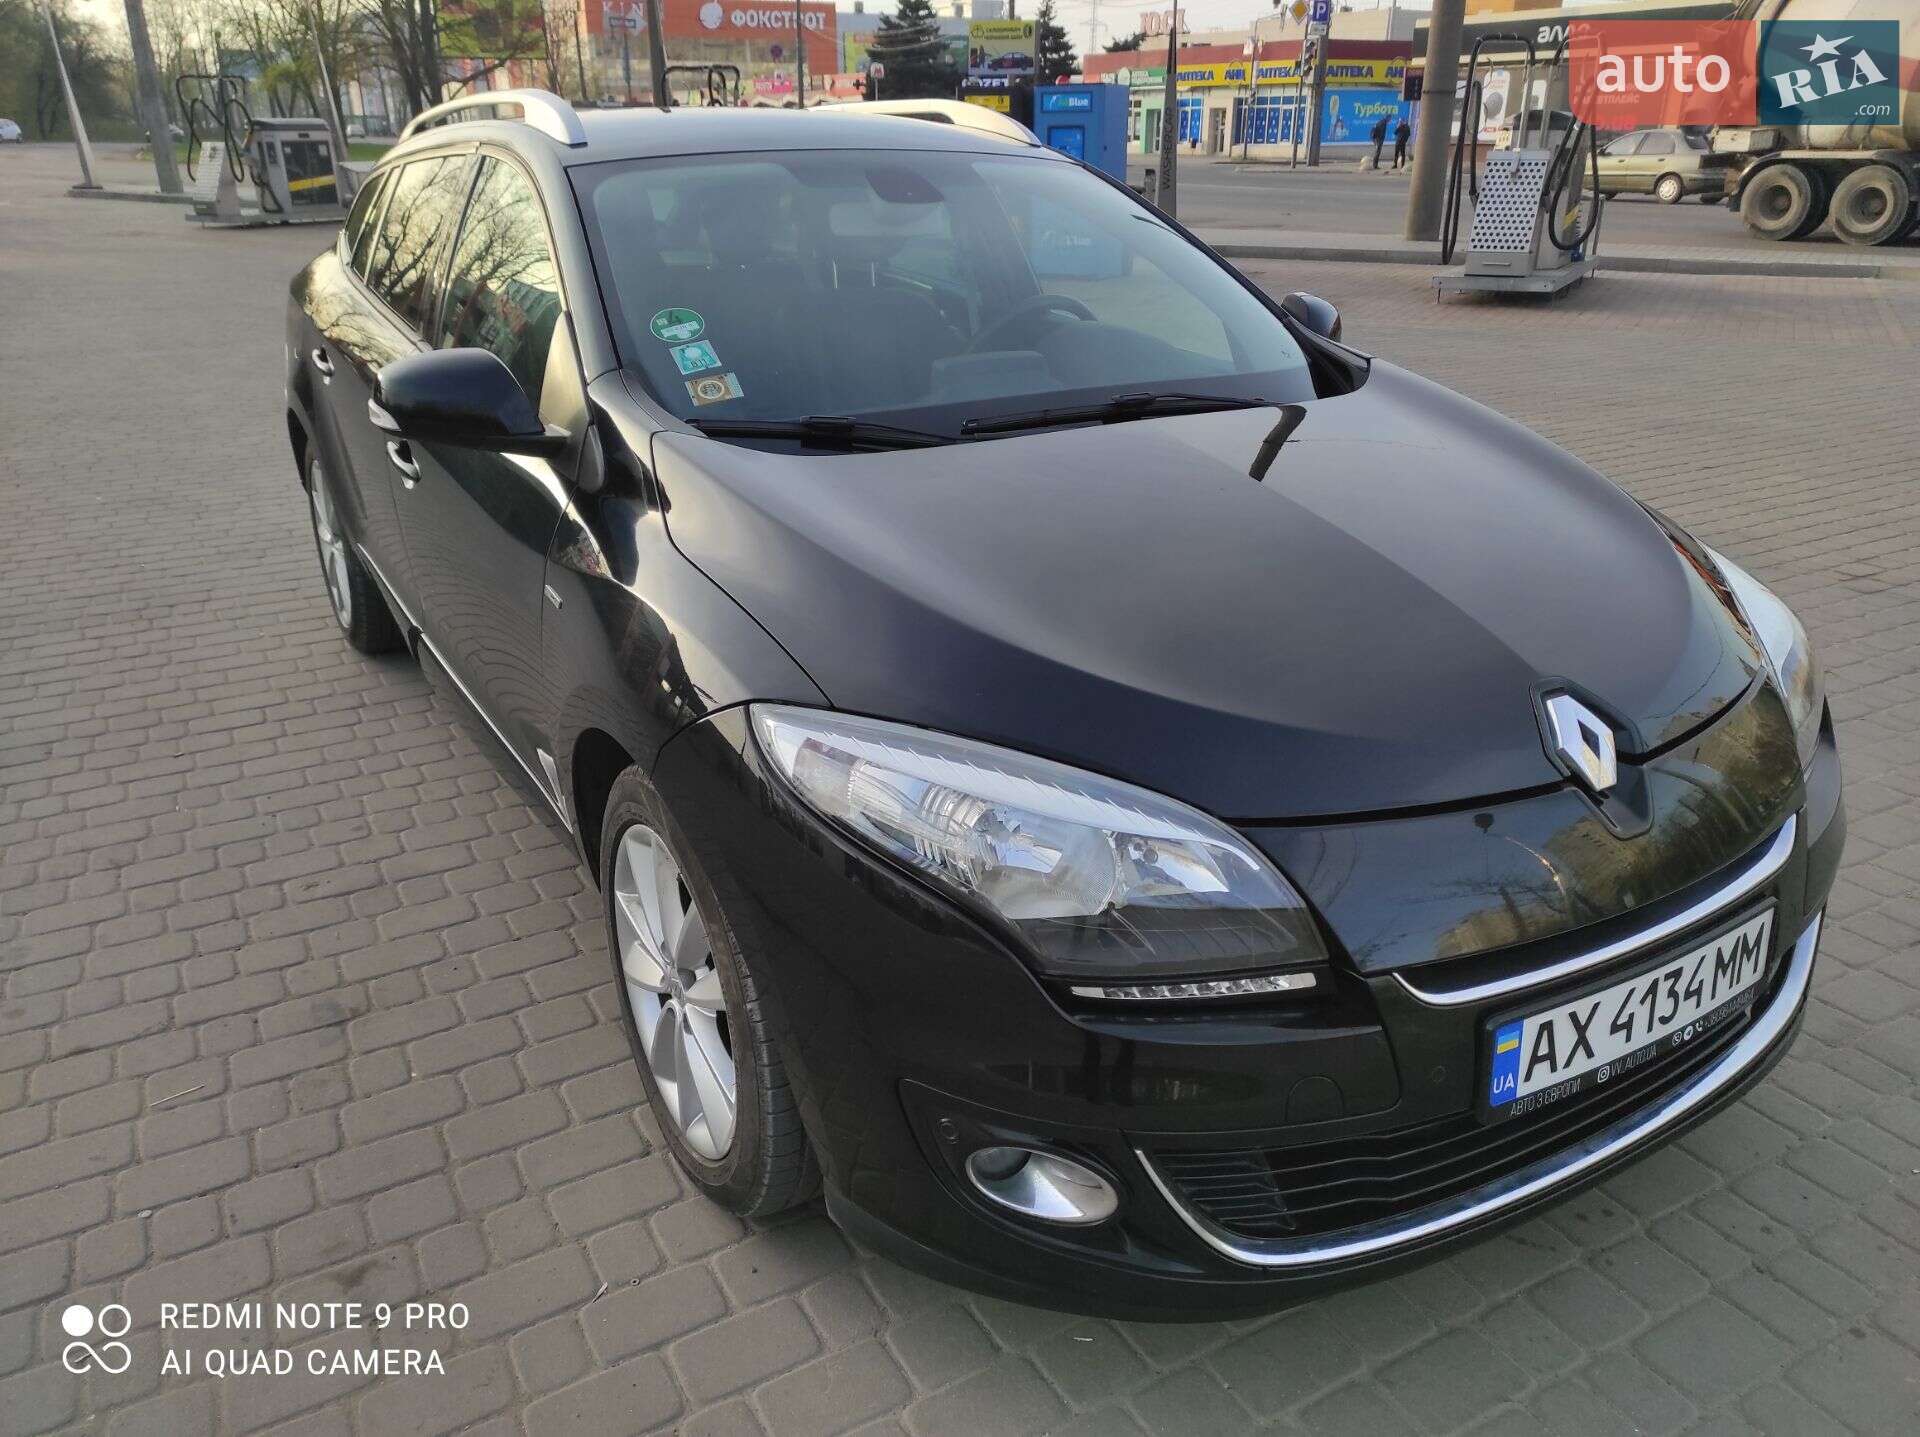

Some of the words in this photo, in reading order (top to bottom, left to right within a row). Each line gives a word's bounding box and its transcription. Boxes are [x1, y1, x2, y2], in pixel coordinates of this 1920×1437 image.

[731, 9, 826, 30] ФОКСТРОТ
[1316, 3, 1327, 18] P
[1327, 66, 1374, 78] АПТЕКА
[1353, 102, 1399, 117] Турбота
[1524, 1001, 1600, 1082] AX
[1609, 953, 1706, 1044] 4134
[1711, 922, 1765, 1000] MM
[1493, 1072, 1515, 1094] UA
